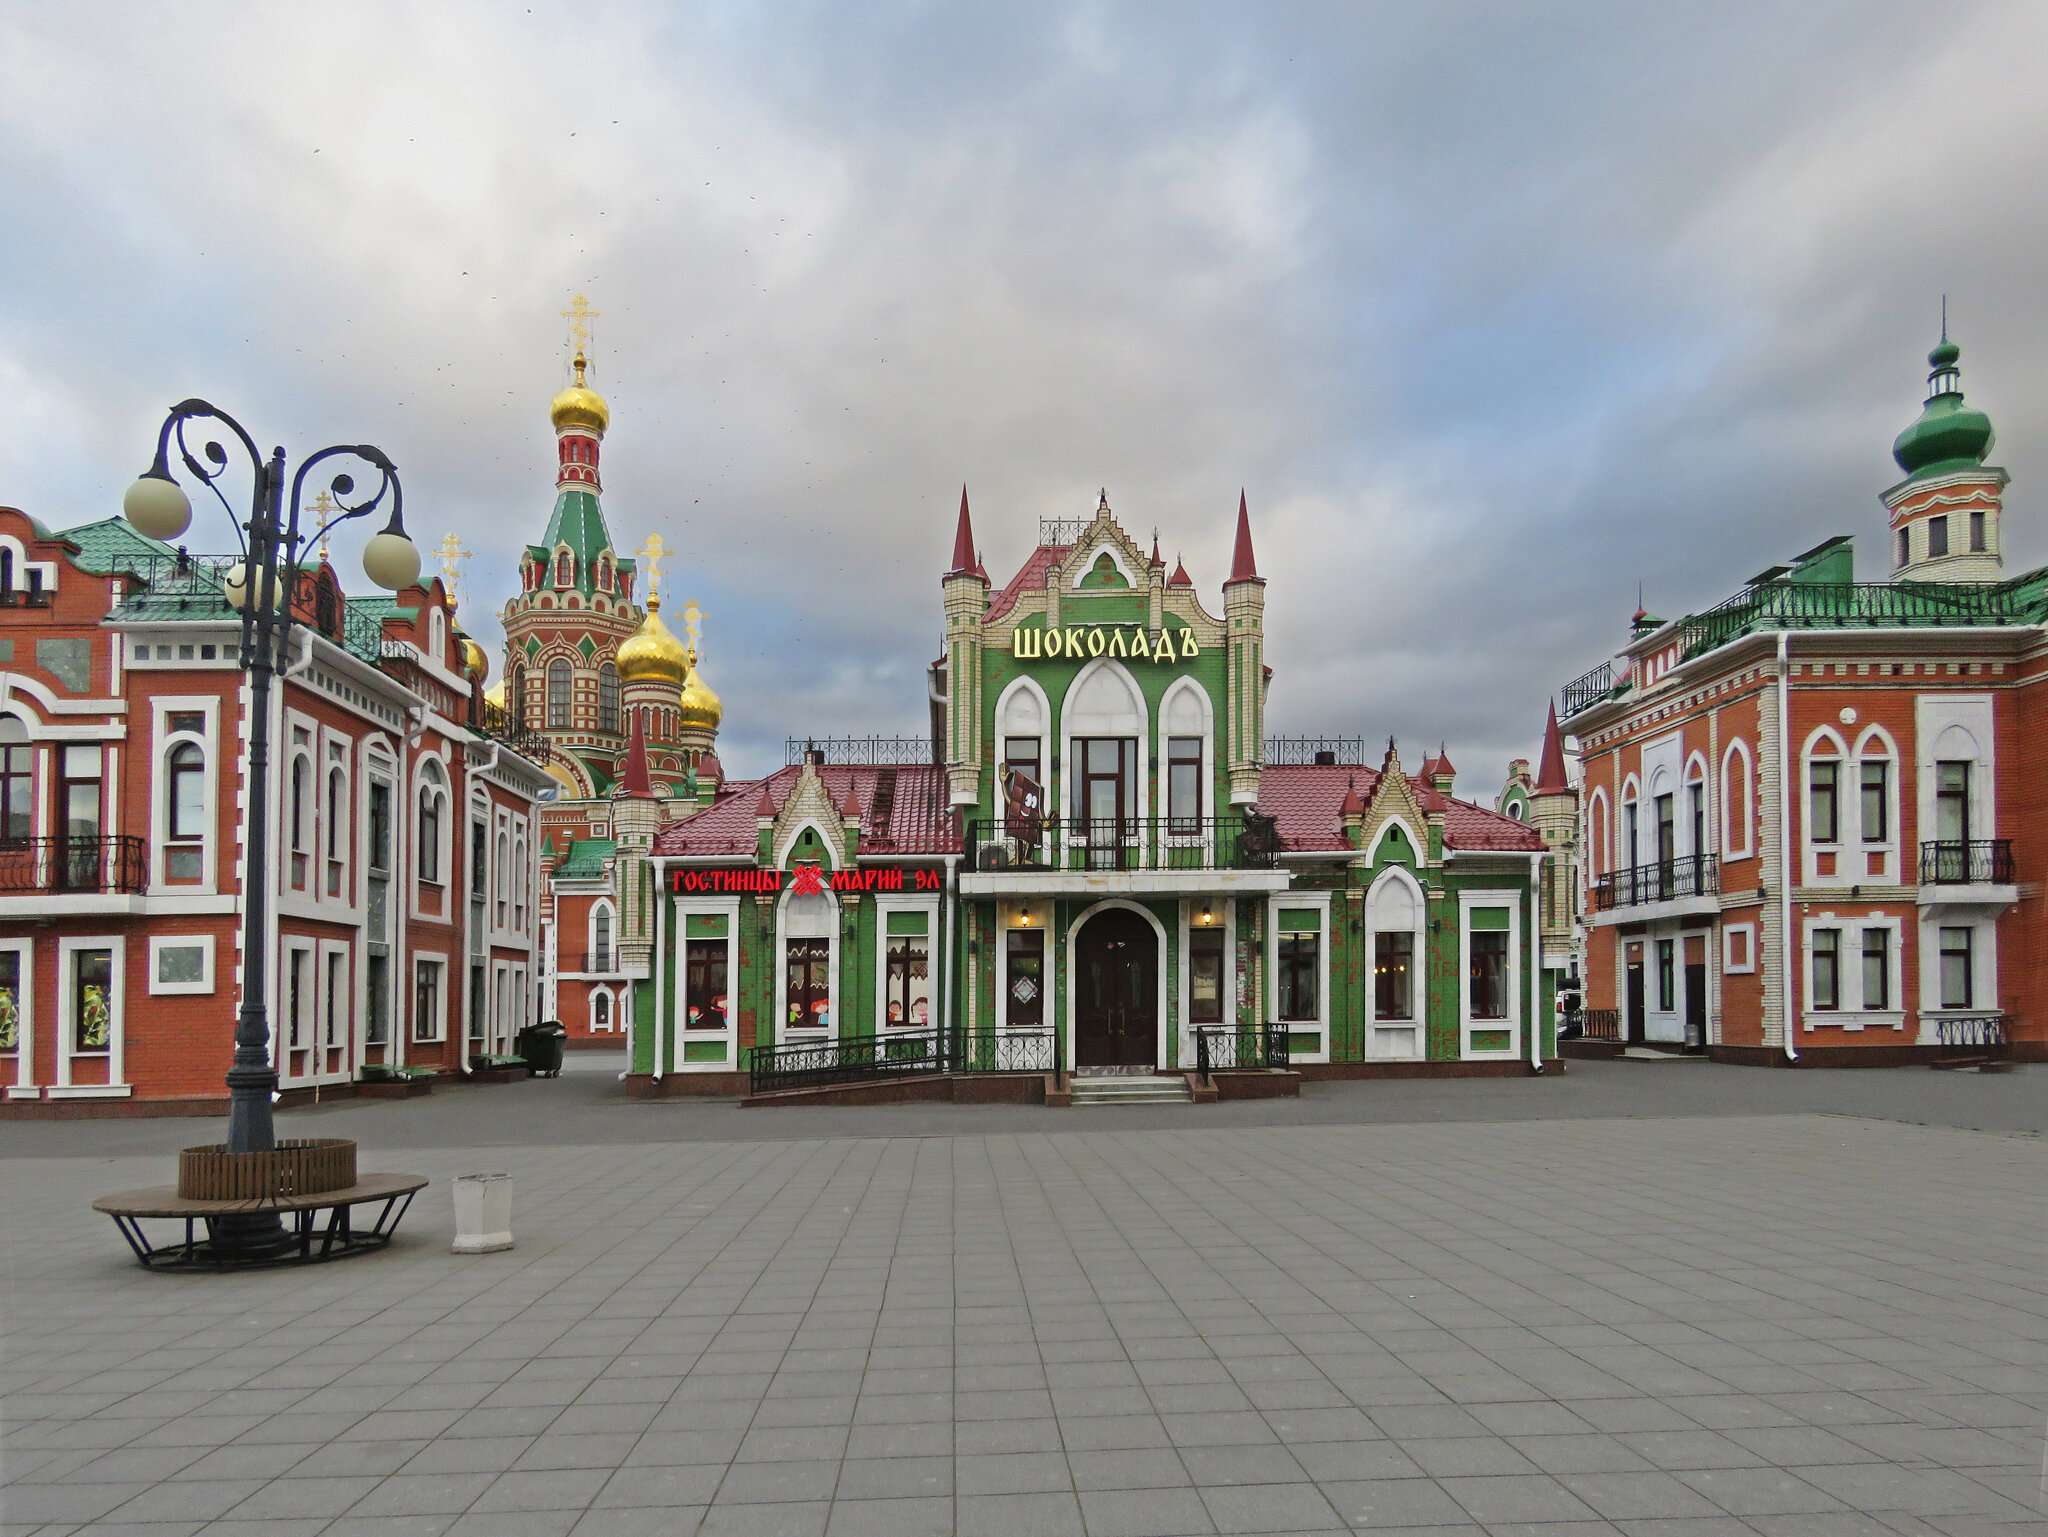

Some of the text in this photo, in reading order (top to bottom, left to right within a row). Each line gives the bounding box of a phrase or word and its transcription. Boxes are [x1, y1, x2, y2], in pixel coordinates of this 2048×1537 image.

[1013, 627, 1200, 664] ШОКОЛАДЪ
[673, 864, 941, 895] ГОСТИНЦЫ МАРИЙ ЭЛ
